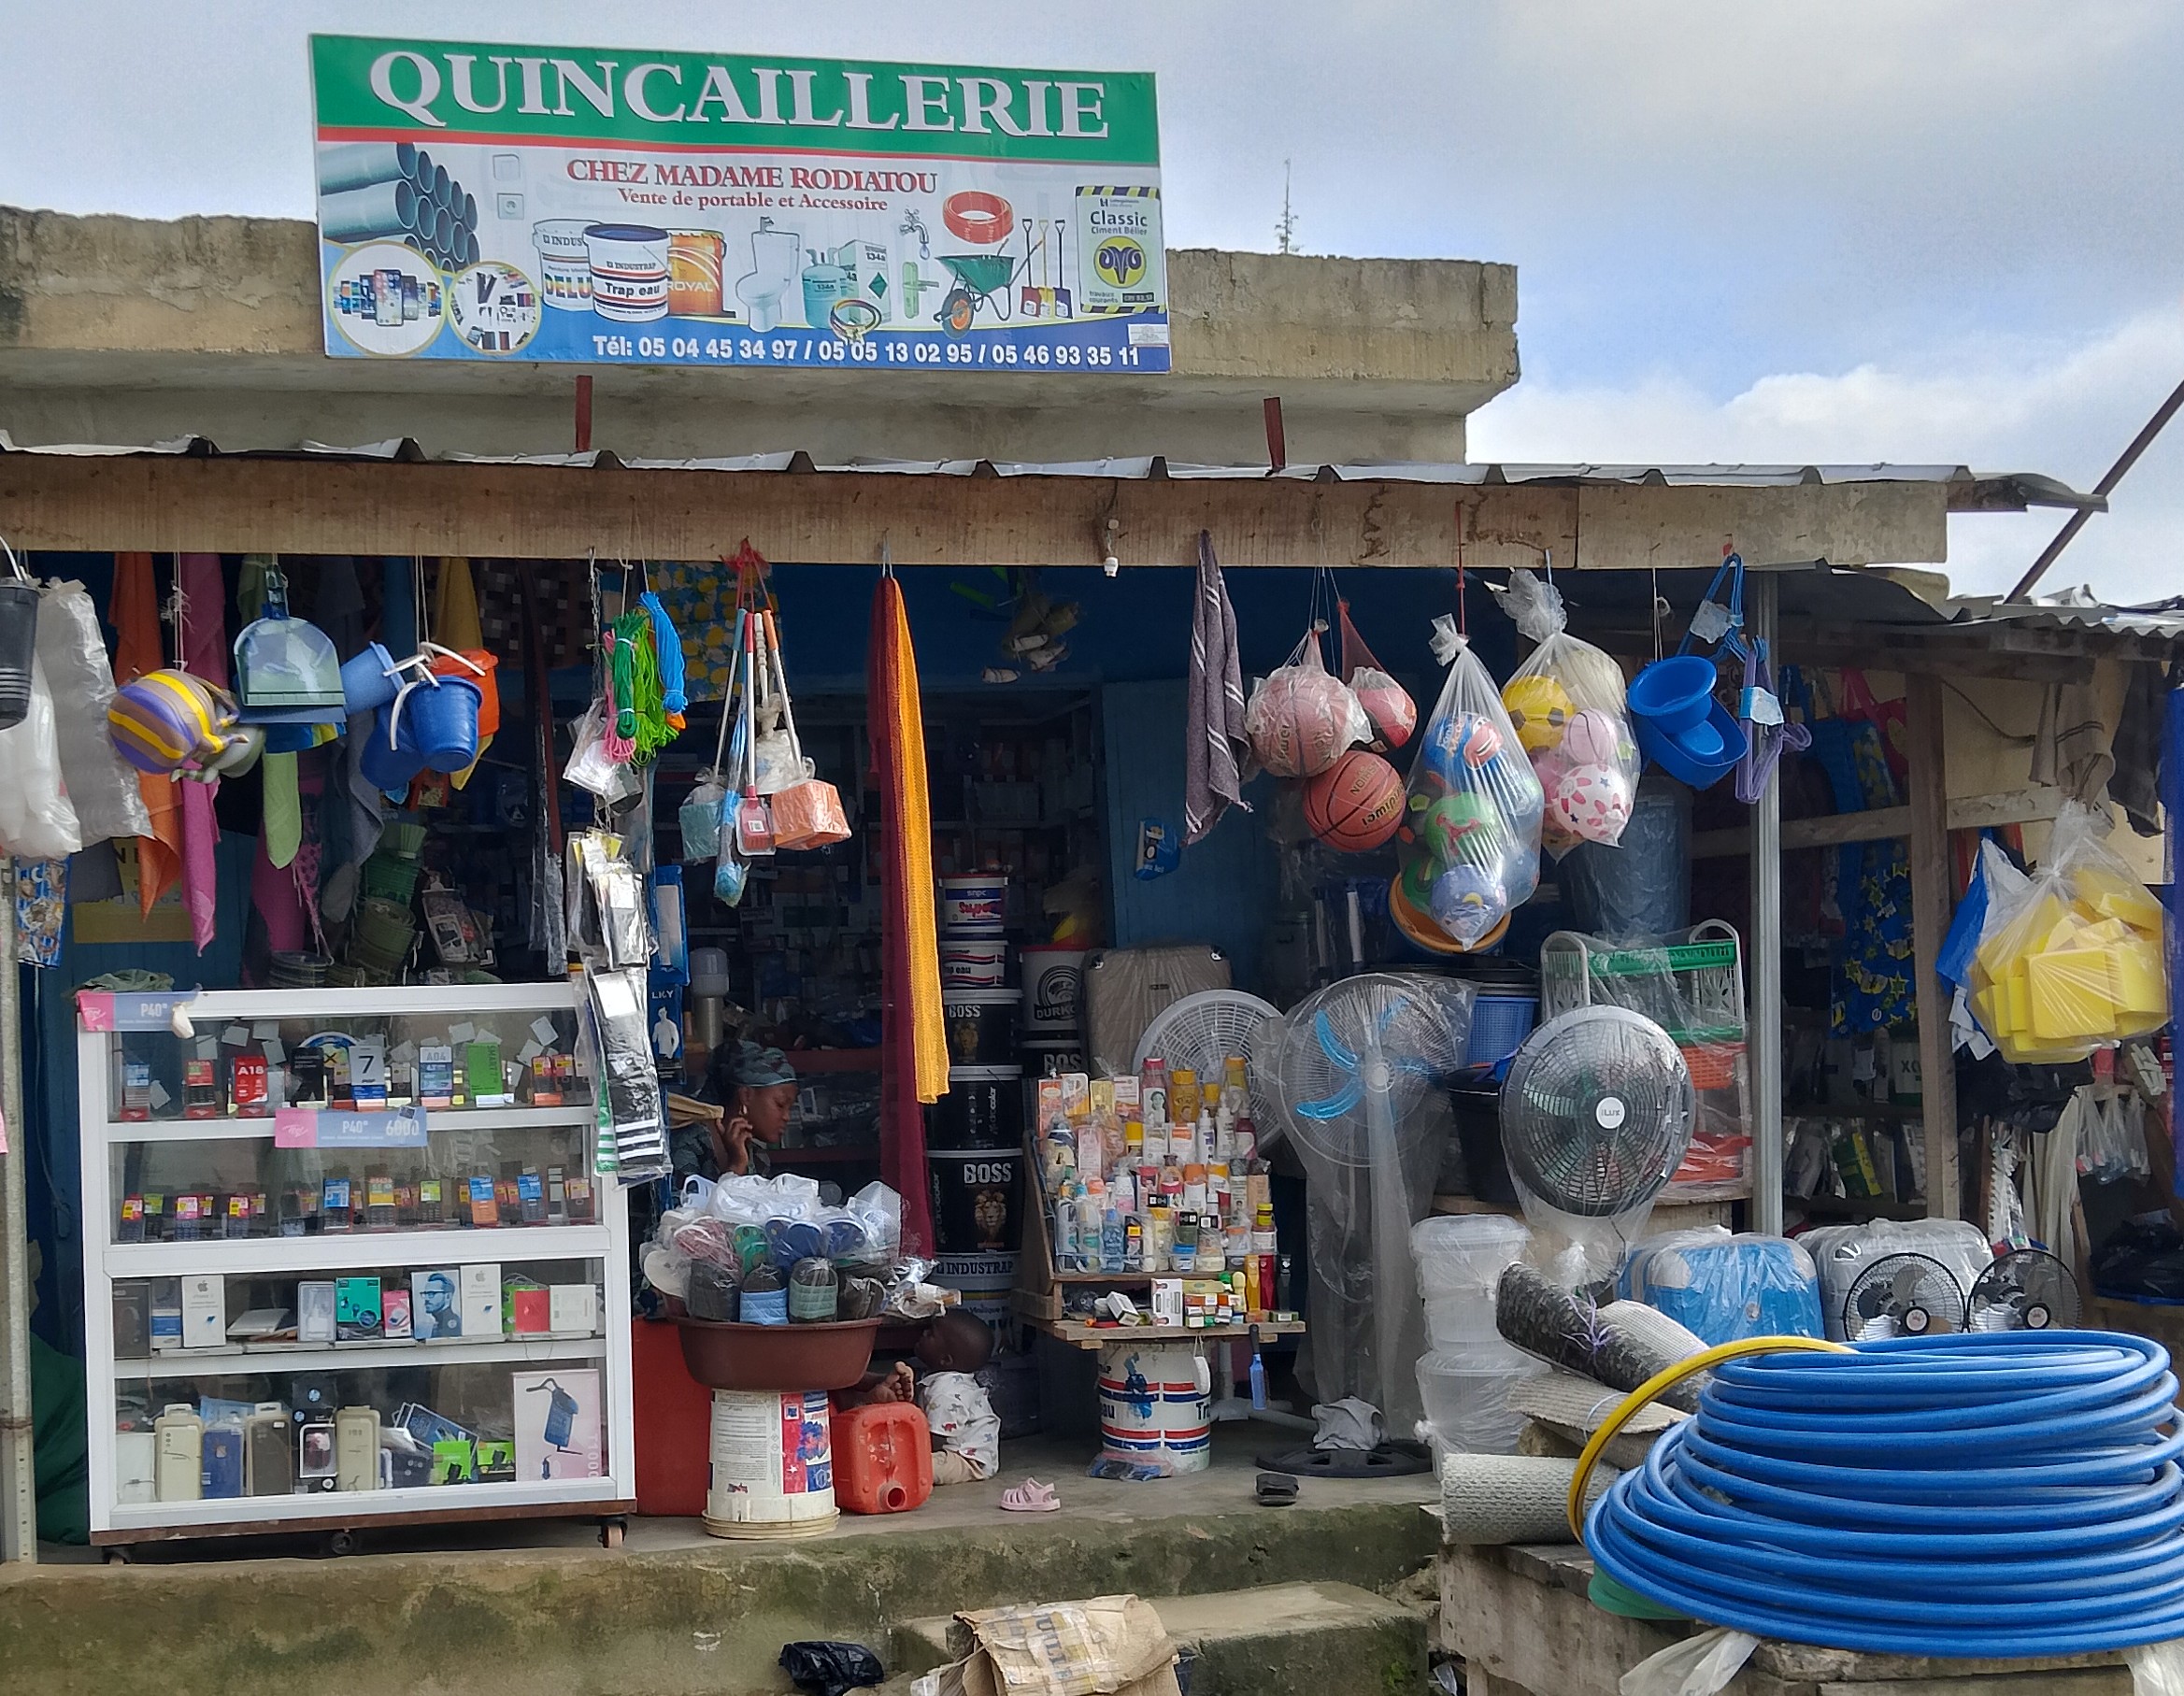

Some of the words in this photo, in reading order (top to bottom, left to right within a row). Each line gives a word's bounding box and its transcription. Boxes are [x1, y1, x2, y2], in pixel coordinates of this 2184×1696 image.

[369, 50, 1109, 138] QUINCAILLERIE
[566, 159, 648, 184] CHEZ
[655, 164, 784, 189] MADAME
[790, 167, 937, 193] RODIATOU
[618, 187, 667, 207] Vente
[672, 191, 692, 207] de
[698, 192, 774, 211] portable
[778, 195, 795, 207] et
[799, 195, 888, 211] Accessoire
[1091, 209, 1148, 226] Classic
[615, 262, 656, 270] INDUSTRAP
[605, 282, 635, 298] Trap
[639, 284, 660, 296] eau
[592, 335, 632, 357] Tél:
[638, 336, 665, 358] 05
[672, 338, 699, 358] 04
[706, 339, 732, 359] 45
[739, 341, 765, 360] 34
[772, 341, 797, 361] 97
[804, 341, 812, 361] /
[819, 341, 844, 361] 05
[851, 342, 877, 362] 05
[885, 343, 908, 363] 13
[915, 344, 941, 363] 02
[947, 344, 972, 363] 95
[978, 344, 986, 363] /
[992, 345, 1017, 363] 05
[1024, 345, 1049, 364] 46
[1055, 346, 1080, 364] 93
[1087, 346, 1111, 365] 35
[1119, 347, 1139, 366] 11
[949, 1005, 980, 1018] BOSS
[358, 1055, 374, 1074] 7
[426, 1052, 446, 1062] A04
[237, 1065, 264, 1075] A18
[964, 1162, 1012, 1184] BOSS
[946, 1261, 1014, 1275] INDUSTRAP
